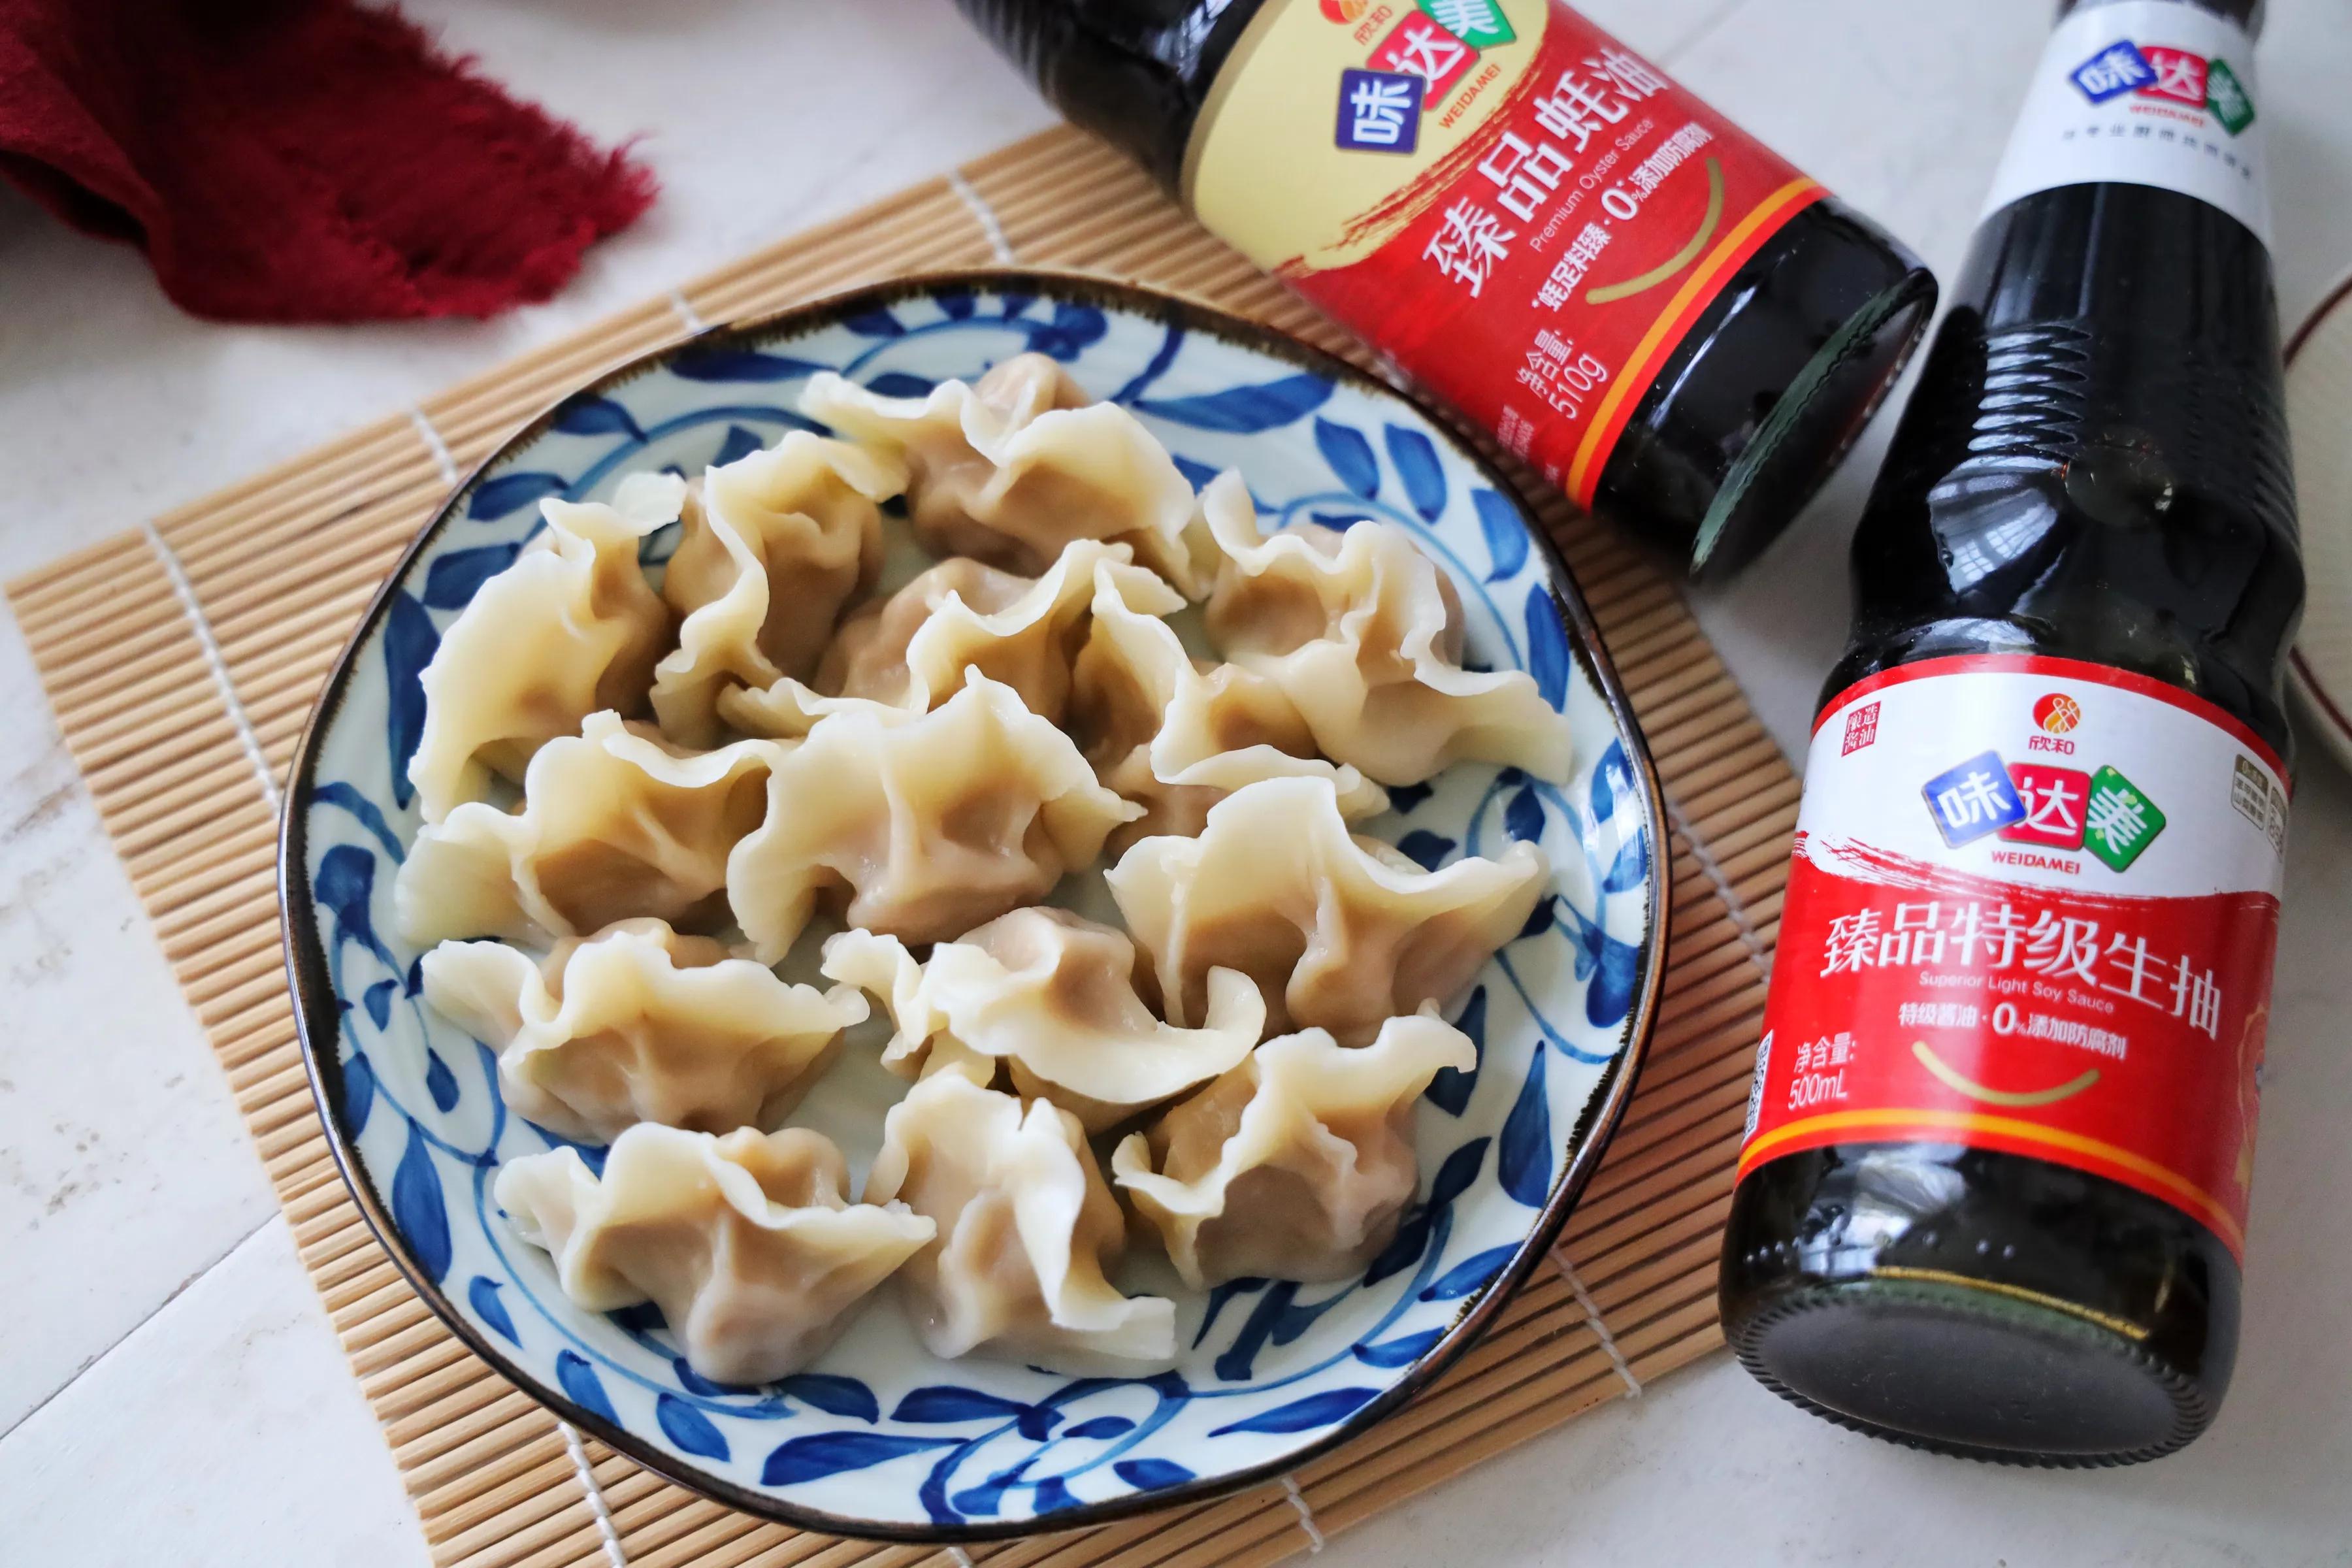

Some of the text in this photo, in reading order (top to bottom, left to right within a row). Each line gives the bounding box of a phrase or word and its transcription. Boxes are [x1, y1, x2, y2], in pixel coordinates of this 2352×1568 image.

[1439, 63, 1501, 129] WEIDAMEI
[1422, 46, 1669, 299] 臻品蚝油
[1529, 116, 1654, 253] Premium Oyster Sauce
[1548, 353, 1608, 419] 510g
[2029, 734, 2076, 755] 欣和
[1940, 771, 2148, 855] 味达美
[1991, 850, 2082, 875] WEIDAMEI
[1820, 901, 2221, 1040] 臻品特级生抽
[1919, 971, 2115, 1013] Superior Light Soy Sauce
[1788, 1068, 1848, 1111] 500mL
